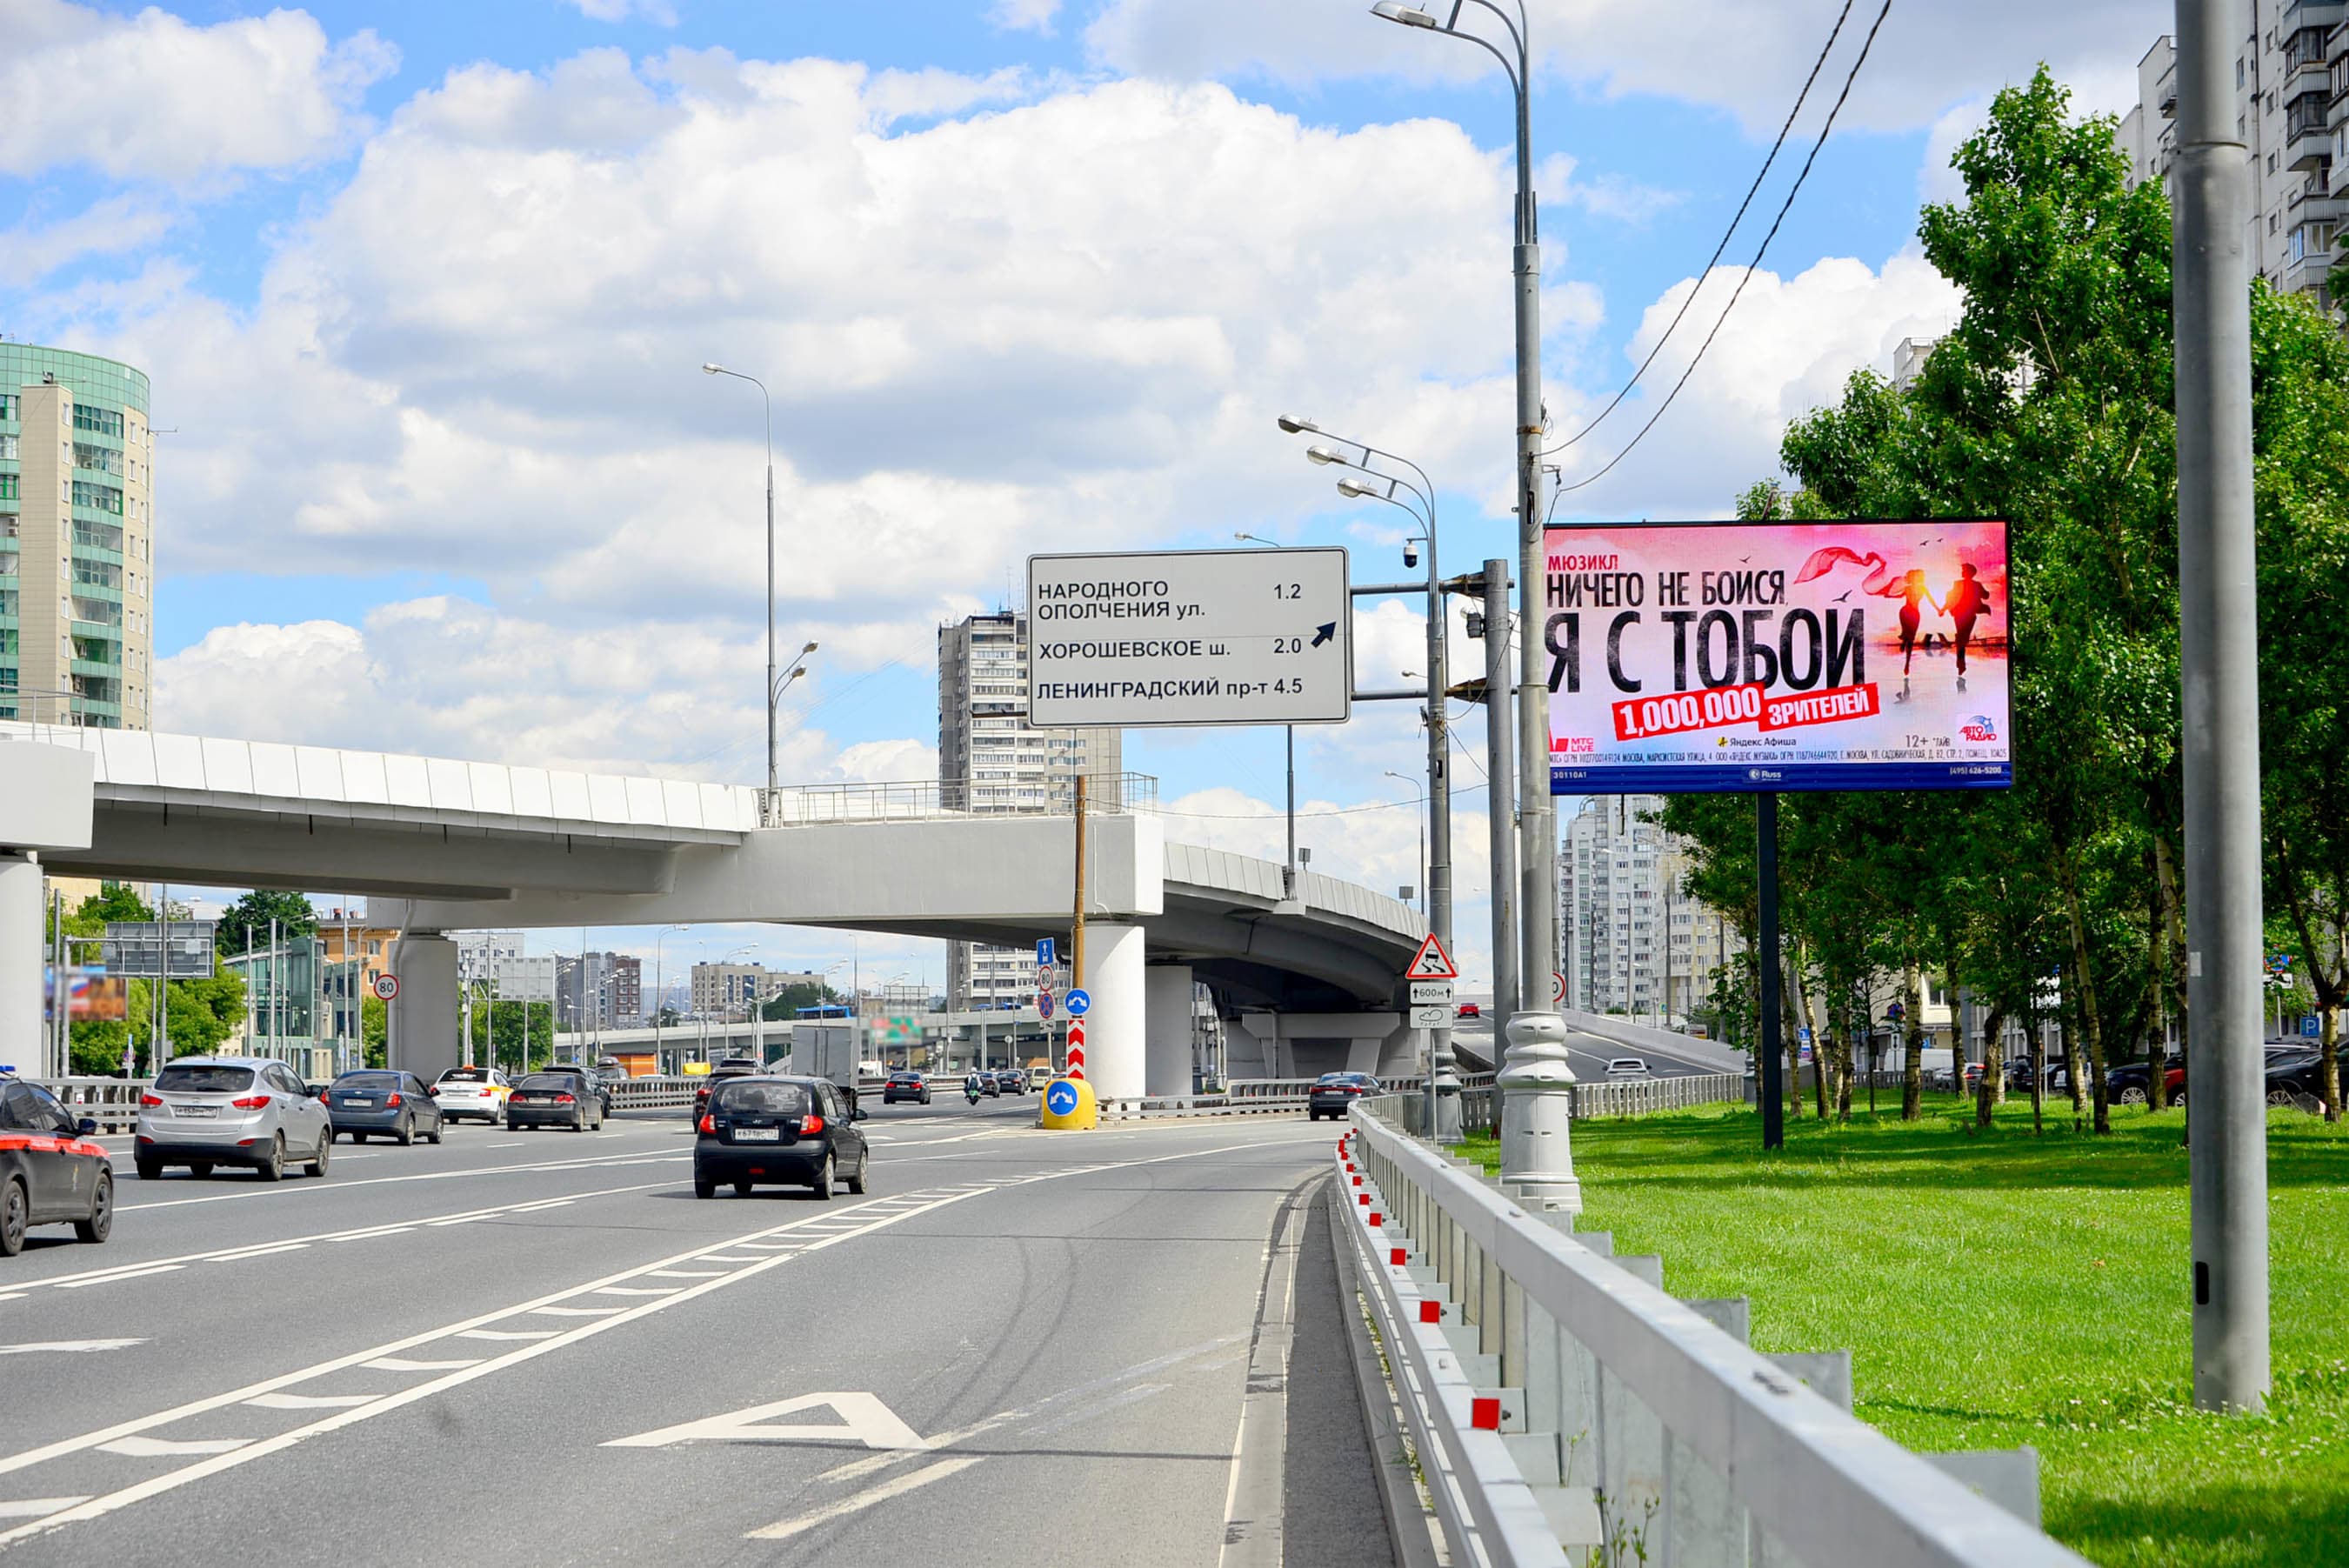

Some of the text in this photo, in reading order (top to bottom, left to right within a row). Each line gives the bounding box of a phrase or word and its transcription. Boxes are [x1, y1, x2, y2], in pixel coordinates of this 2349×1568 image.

[1548, 555, 1618, 570] МЮЗИКЛ
[1038, 581, 1301, 600] НАРОДНОГО 1.2
[1547, 572, 1644, 607] НИЧЕГО
[1658, 572, 1690, 606] НЕ
[1038, 602, 1205, 621] ОПОЛЧЕНИЯ ул.
[1039, 638, 1301, 659] ХОРОШЕВСКОЕ ш. 2.0
[1544, 611, 1580, 693] Я
[1607, 611, 1641, 693] С
[1038, 676, 1302, 699] ЛЕНИНГРАДСКИЙ пр-т 4.5
[1619, 686, 1870, 737] 1,000,000 ЗРИТЕЛЕЙ
[1959, 725, 1984, 734] АВТО
[1965, 733, 1997, 742] РАДИО
[1730, 737, 1796, 747] Яндекс Афиша
[1905, 735, 1929, 748] 12+
[379, 982, 394, 993] 80
